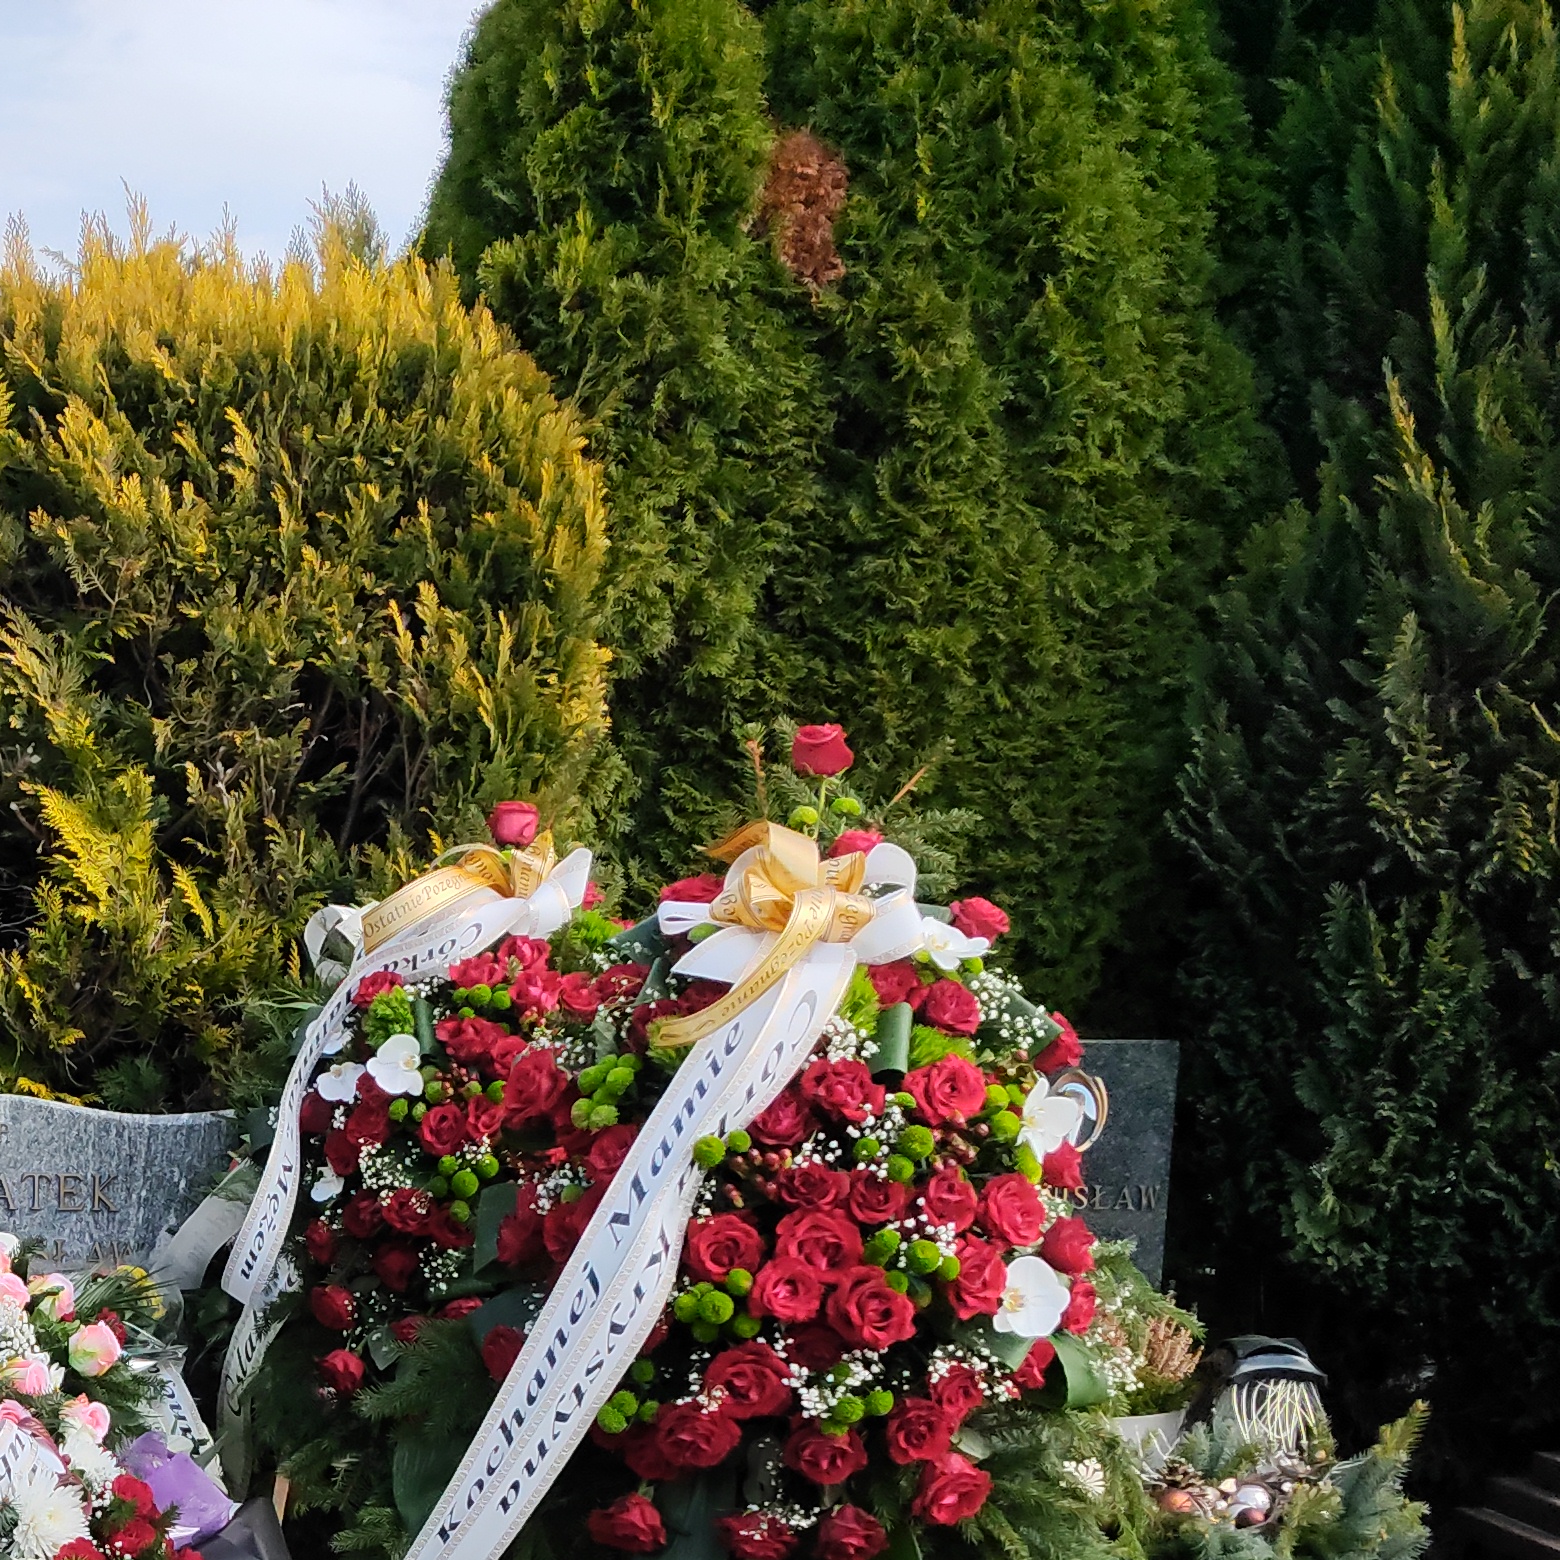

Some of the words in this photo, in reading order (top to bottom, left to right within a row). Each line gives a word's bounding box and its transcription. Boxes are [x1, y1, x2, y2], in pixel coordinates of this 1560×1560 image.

[363, 893, 423, 938] Ostatnie
[240, 1153, 294, 1281] Mężem
[437, 1259, 602, 1545] Kochanej
[607, 1021, 744, 1250] Mamie
[495, 1222, 671, 1518] Krystyna
